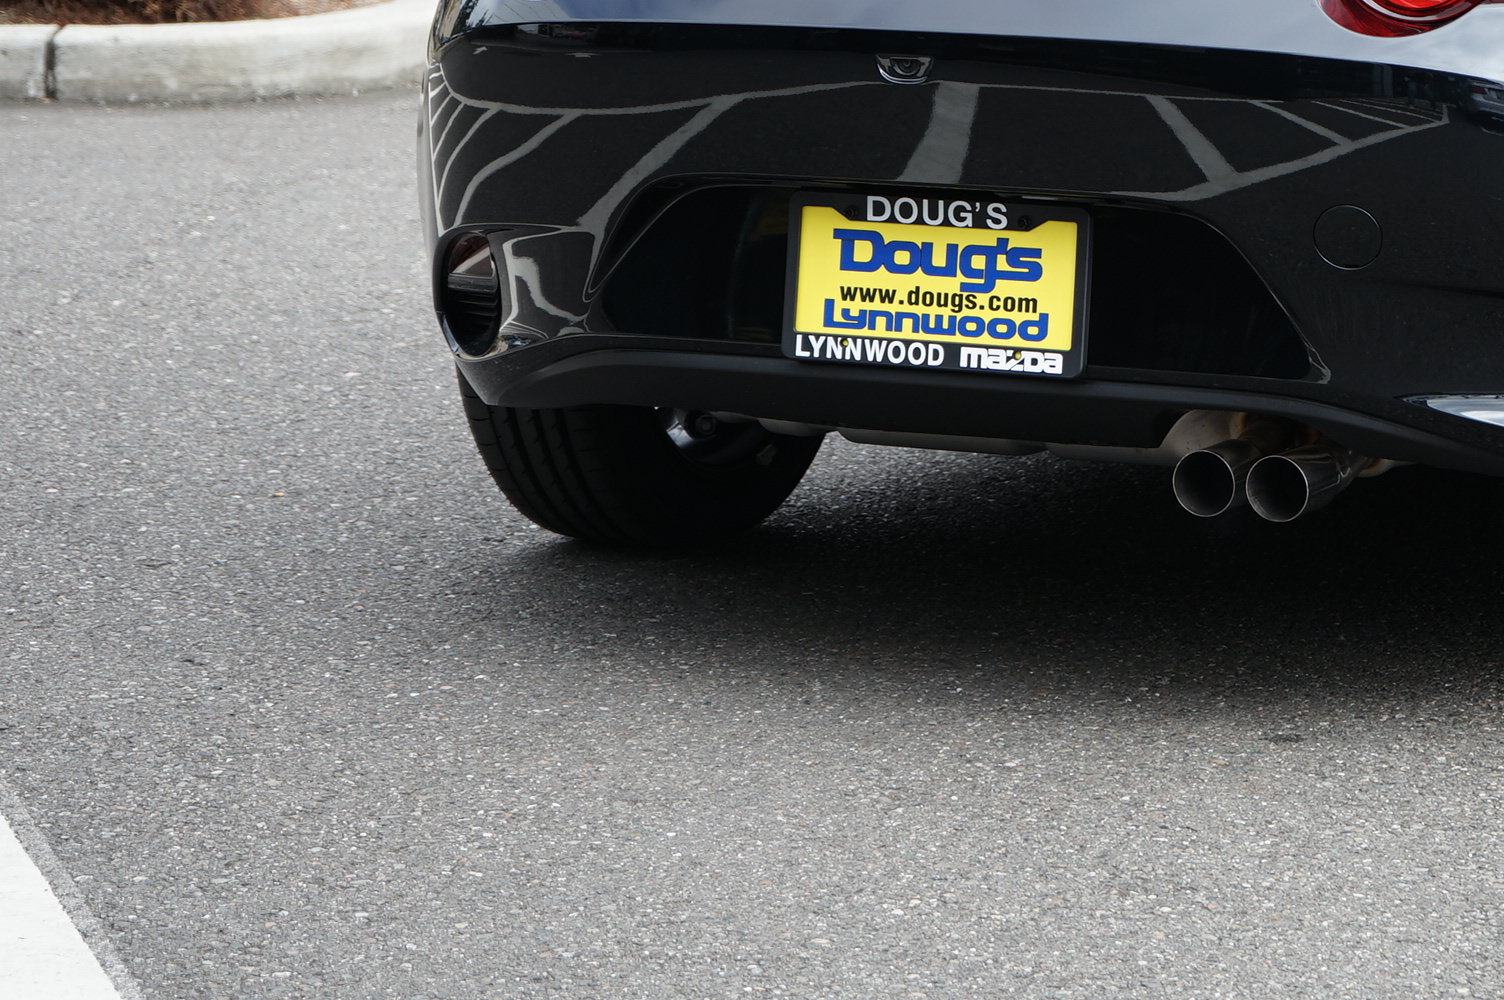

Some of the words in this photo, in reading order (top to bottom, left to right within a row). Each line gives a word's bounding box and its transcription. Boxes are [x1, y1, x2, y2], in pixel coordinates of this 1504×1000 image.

[866, 195, 1009, 230] DOUG'S
[833, 228, 1043, 294] Doug's
[840, 285, 1038, 314] www.dougs.com
[822, 298, 1050, 342] Lynnwood
[795, 334, 945, 367] LYNNWOOD
